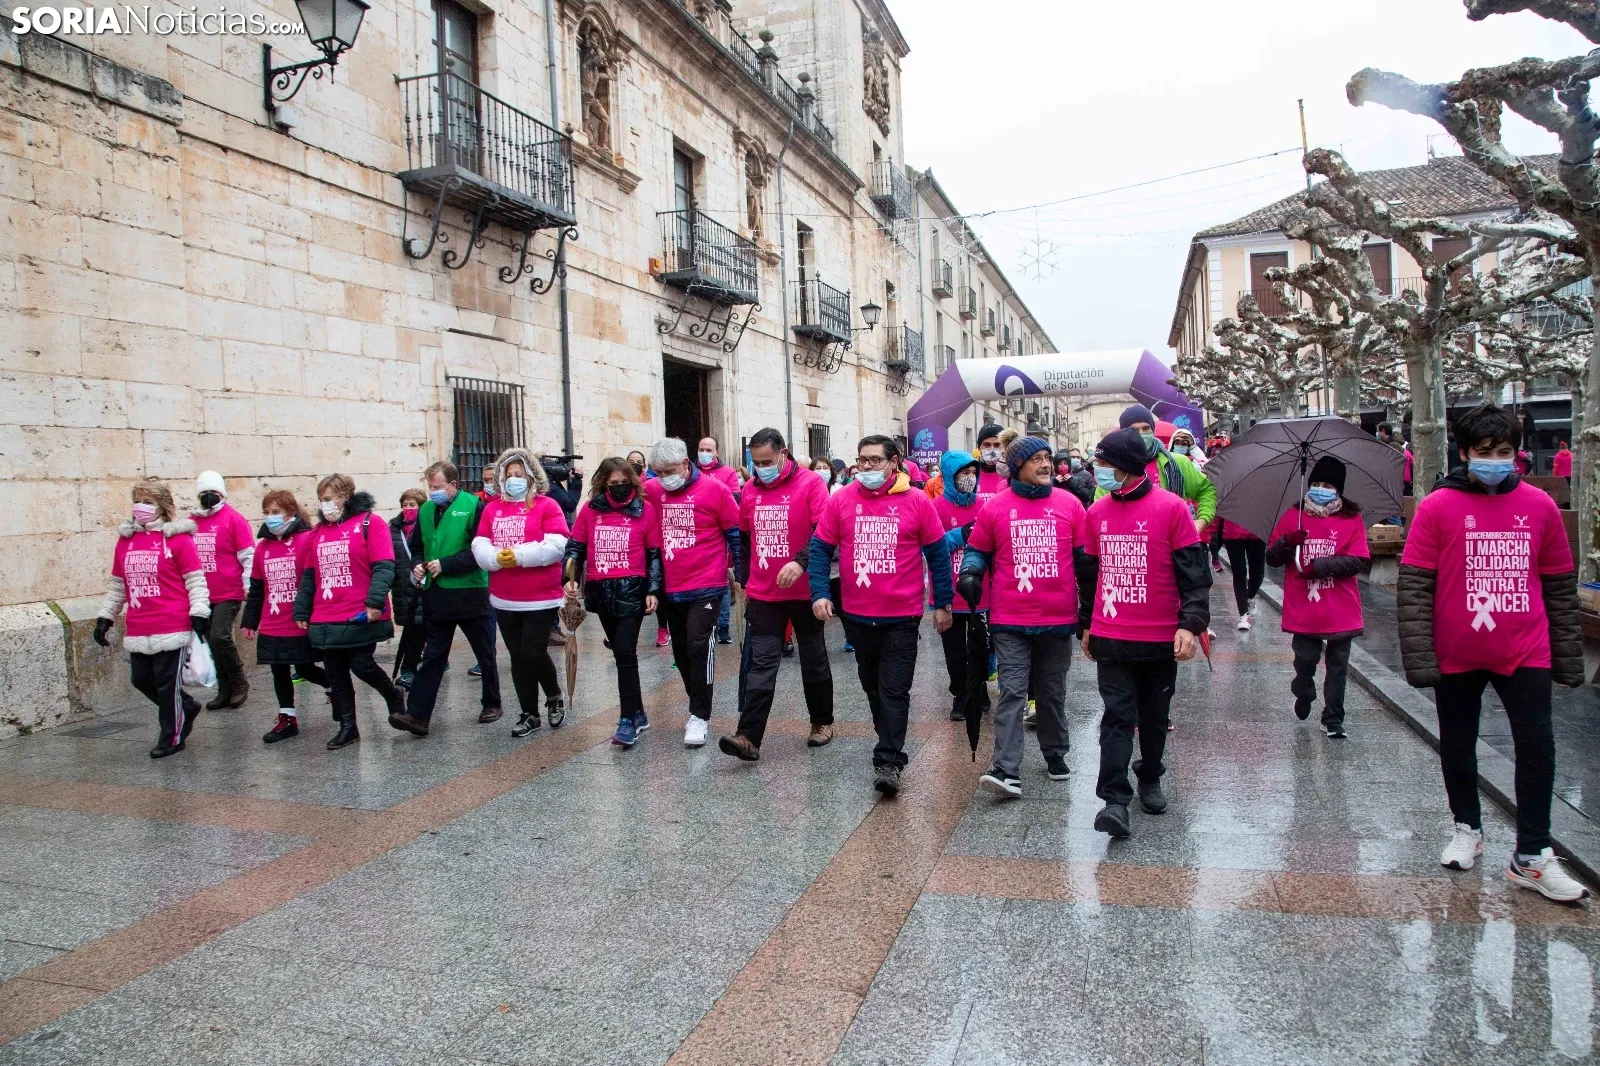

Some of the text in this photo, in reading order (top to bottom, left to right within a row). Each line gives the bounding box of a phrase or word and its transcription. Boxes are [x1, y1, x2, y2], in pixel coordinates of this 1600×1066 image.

[1044, 368, 1104, 382] Diputación
[1044, 380, 1089, 391] de Soria
[928, 450, 942, 458] puro
[667, 509, 694, 518] MARCHA
[759, 510, 789, 521] MARCHA
[498, 520, 525, 529] MARCHA
[662, 518, 695, 527] SOLIDARIA
[754, 521, 789, 531] SOLIDARIA
[861, 522, 899, 534] MARCHA
[493, 529, 525, 537] SOLIDARIA
[600, 530, 630, 541] MARCHA
[1018, 525, 1057, 537] MARCHA
[756, 535, 789, 544] CONTRA EL
[854, 533, 898, 544] SOLIDARIA
[1012, 537, 1057, 548] SOLIDARIA
[321, 545, 350, 556] MARCHA
[594, 540, 629, 550] SOLIDARIA
[1106, 542, 1148, 556] MARCHA
[1477, 540, 1530, 556] MARCHA
[318, 554, 350, 565] SOLIDARIA
[595, 553, 618, 561] CONTRA
[854, 549, 897, 559] CONTRA EL
[1013, 553, 1058, 564] CONTRA EL
[129, 555, 158, 565] MARCHA
[1102, 555, 1147, 568] SOLIDARIA
[1466, 556, 1530, 570] SOLIDARIA
[124, 564, 158, 574] SOLIDARIA
[268, 561, 296, 573] MARCHA
[342, 566, 352, 575] EL
[266, 570, 297, 580] SOLIDARIA
[1102, 573, 1147, 586] CONTRA EL
[1466, 578, 1529, 592] CONTRA EL
